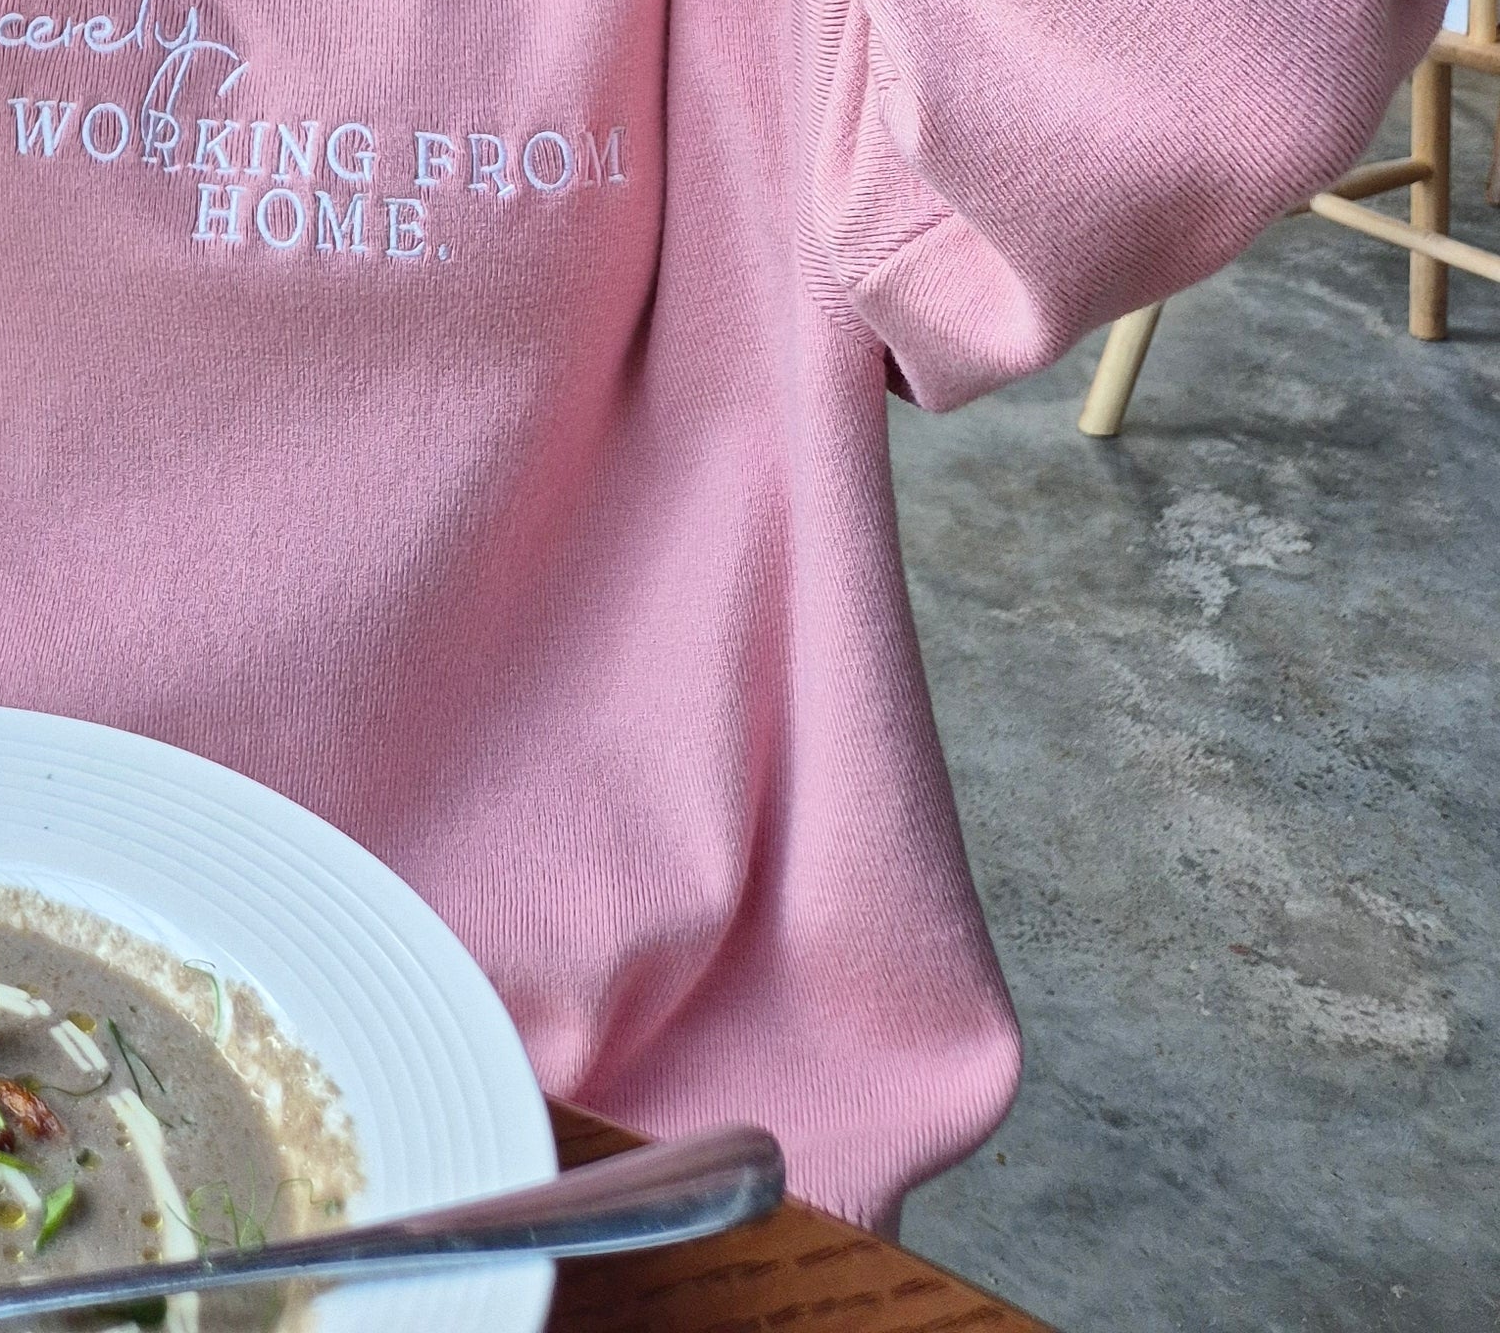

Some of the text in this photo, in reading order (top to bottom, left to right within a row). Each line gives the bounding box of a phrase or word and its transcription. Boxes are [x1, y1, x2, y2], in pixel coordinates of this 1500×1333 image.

[7, 96, 628, 198] WORKING FROM
[191, 182, 450, 262] HOME.
